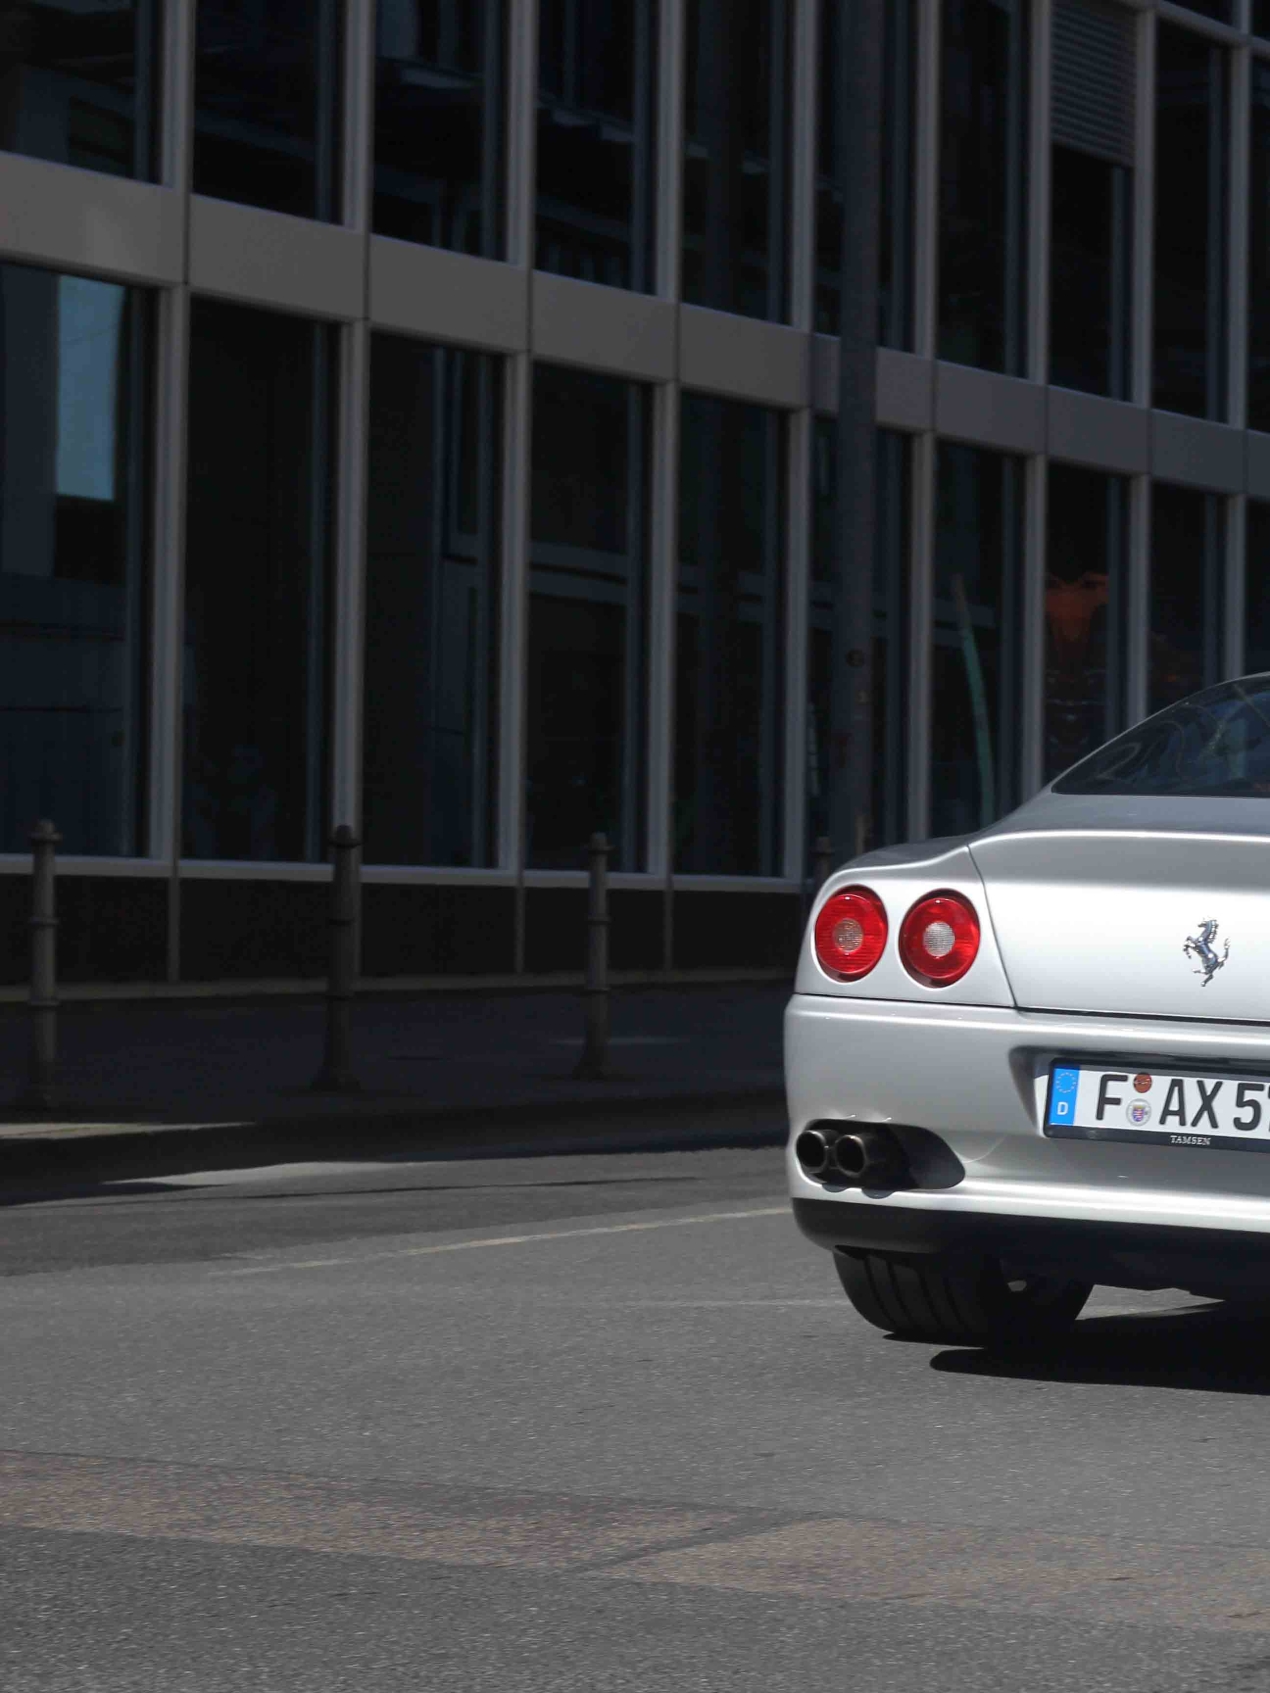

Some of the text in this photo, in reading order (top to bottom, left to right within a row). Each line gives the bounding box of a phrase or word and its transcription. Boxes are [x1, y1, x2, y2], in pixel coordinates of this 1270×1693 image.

[1057, 1101, 1069, 1115] D
[1096, 1074, 1129, 1121] F
[1159, 1078, 1223, 1129] AX
[1170, 1134, 1211, 1146] TAMSEN
